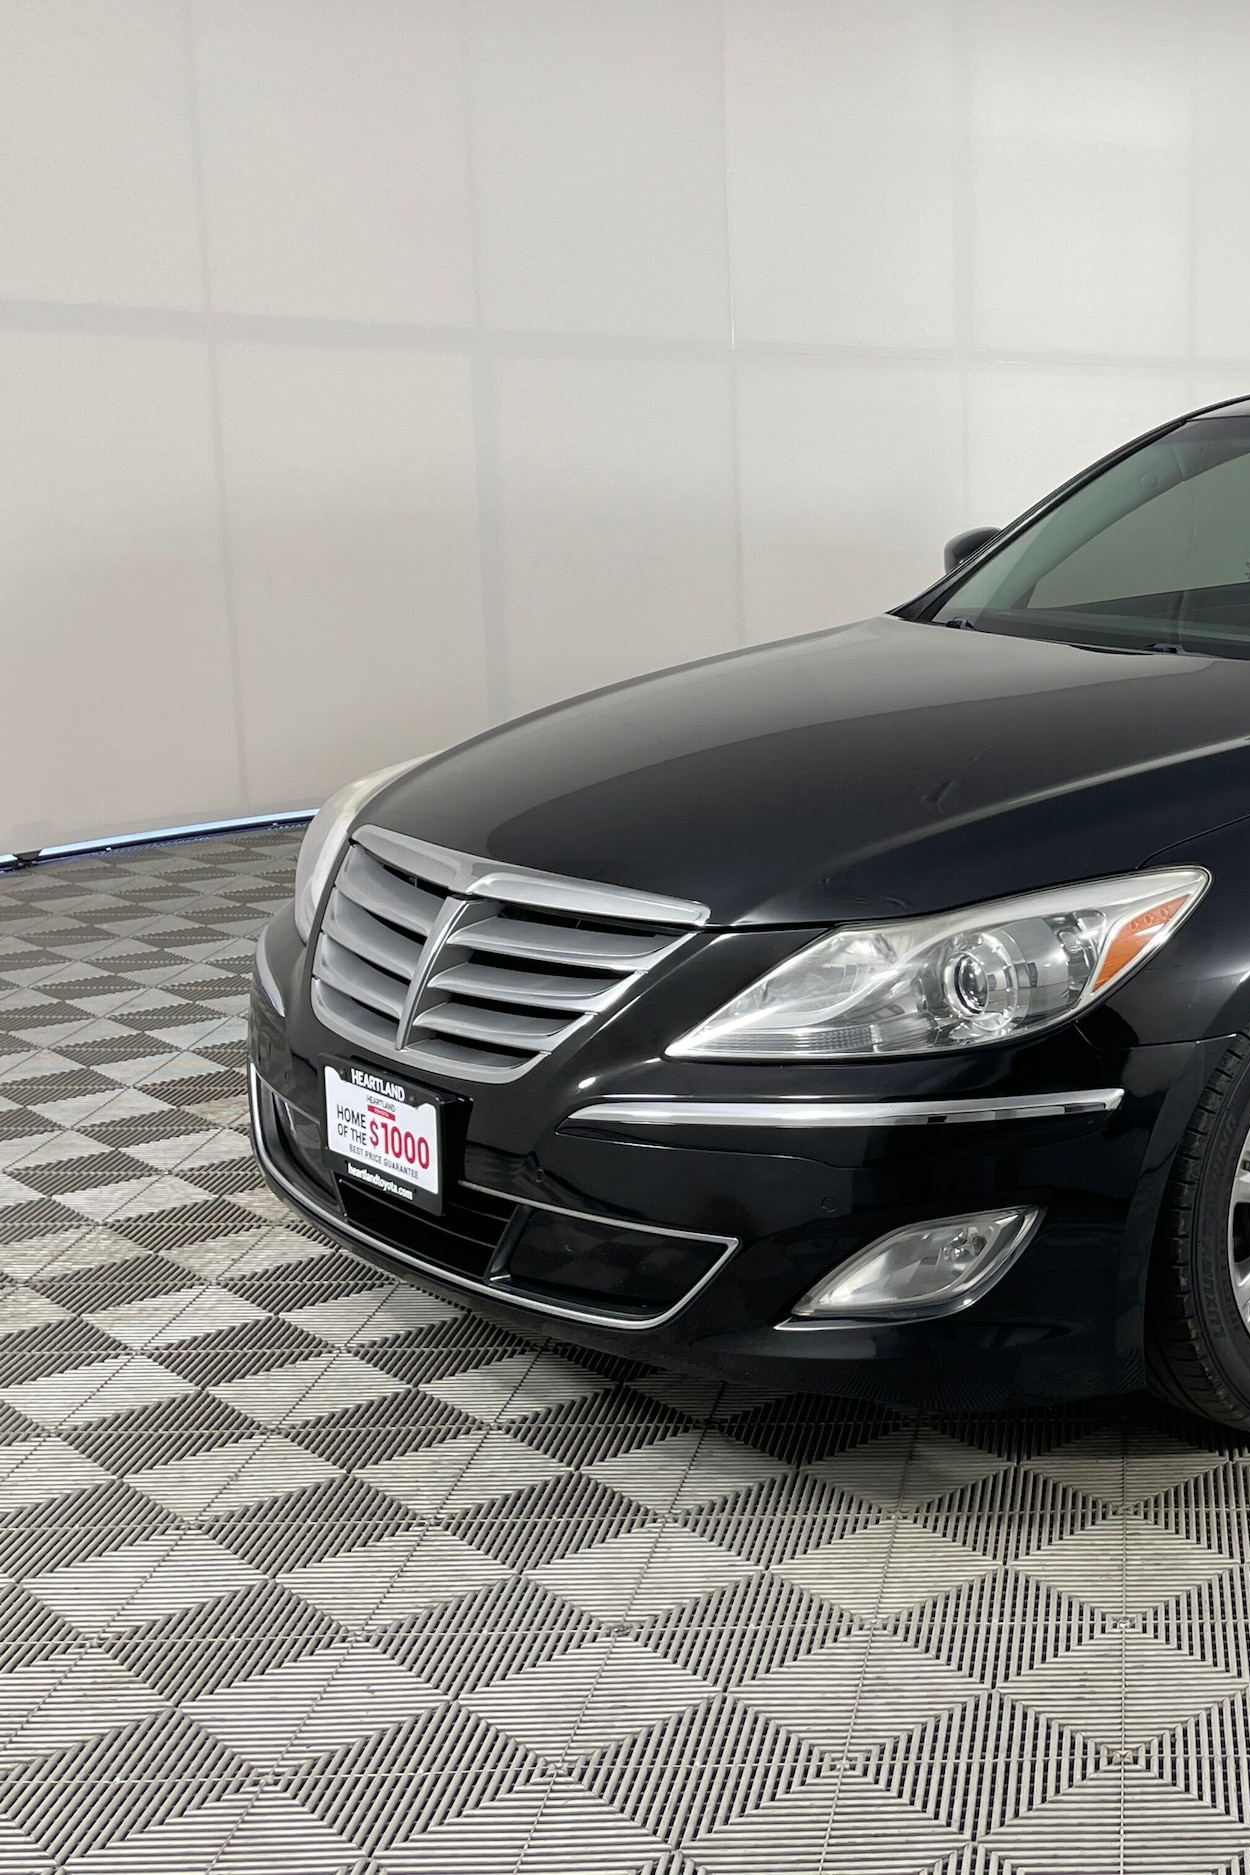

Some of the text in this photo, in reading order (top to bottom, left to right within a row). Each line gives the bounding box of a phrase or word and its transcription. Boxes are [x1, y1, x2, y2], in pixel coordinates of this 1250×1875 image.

[351, 1068, 405, 1101] HEARTLAND
[336, 1104, 366, 1129] HOME
[366, 1095, 396, 1113] HEARTLAND
[337, 1123, 367, 1146] OF THE
[369, 1118, 430, 1170] $1000
[349, 1144, 418, 1180] BEST PRICE GUARANTEE
[347, 1162, 413, 1200] heartlandtoyota.com
